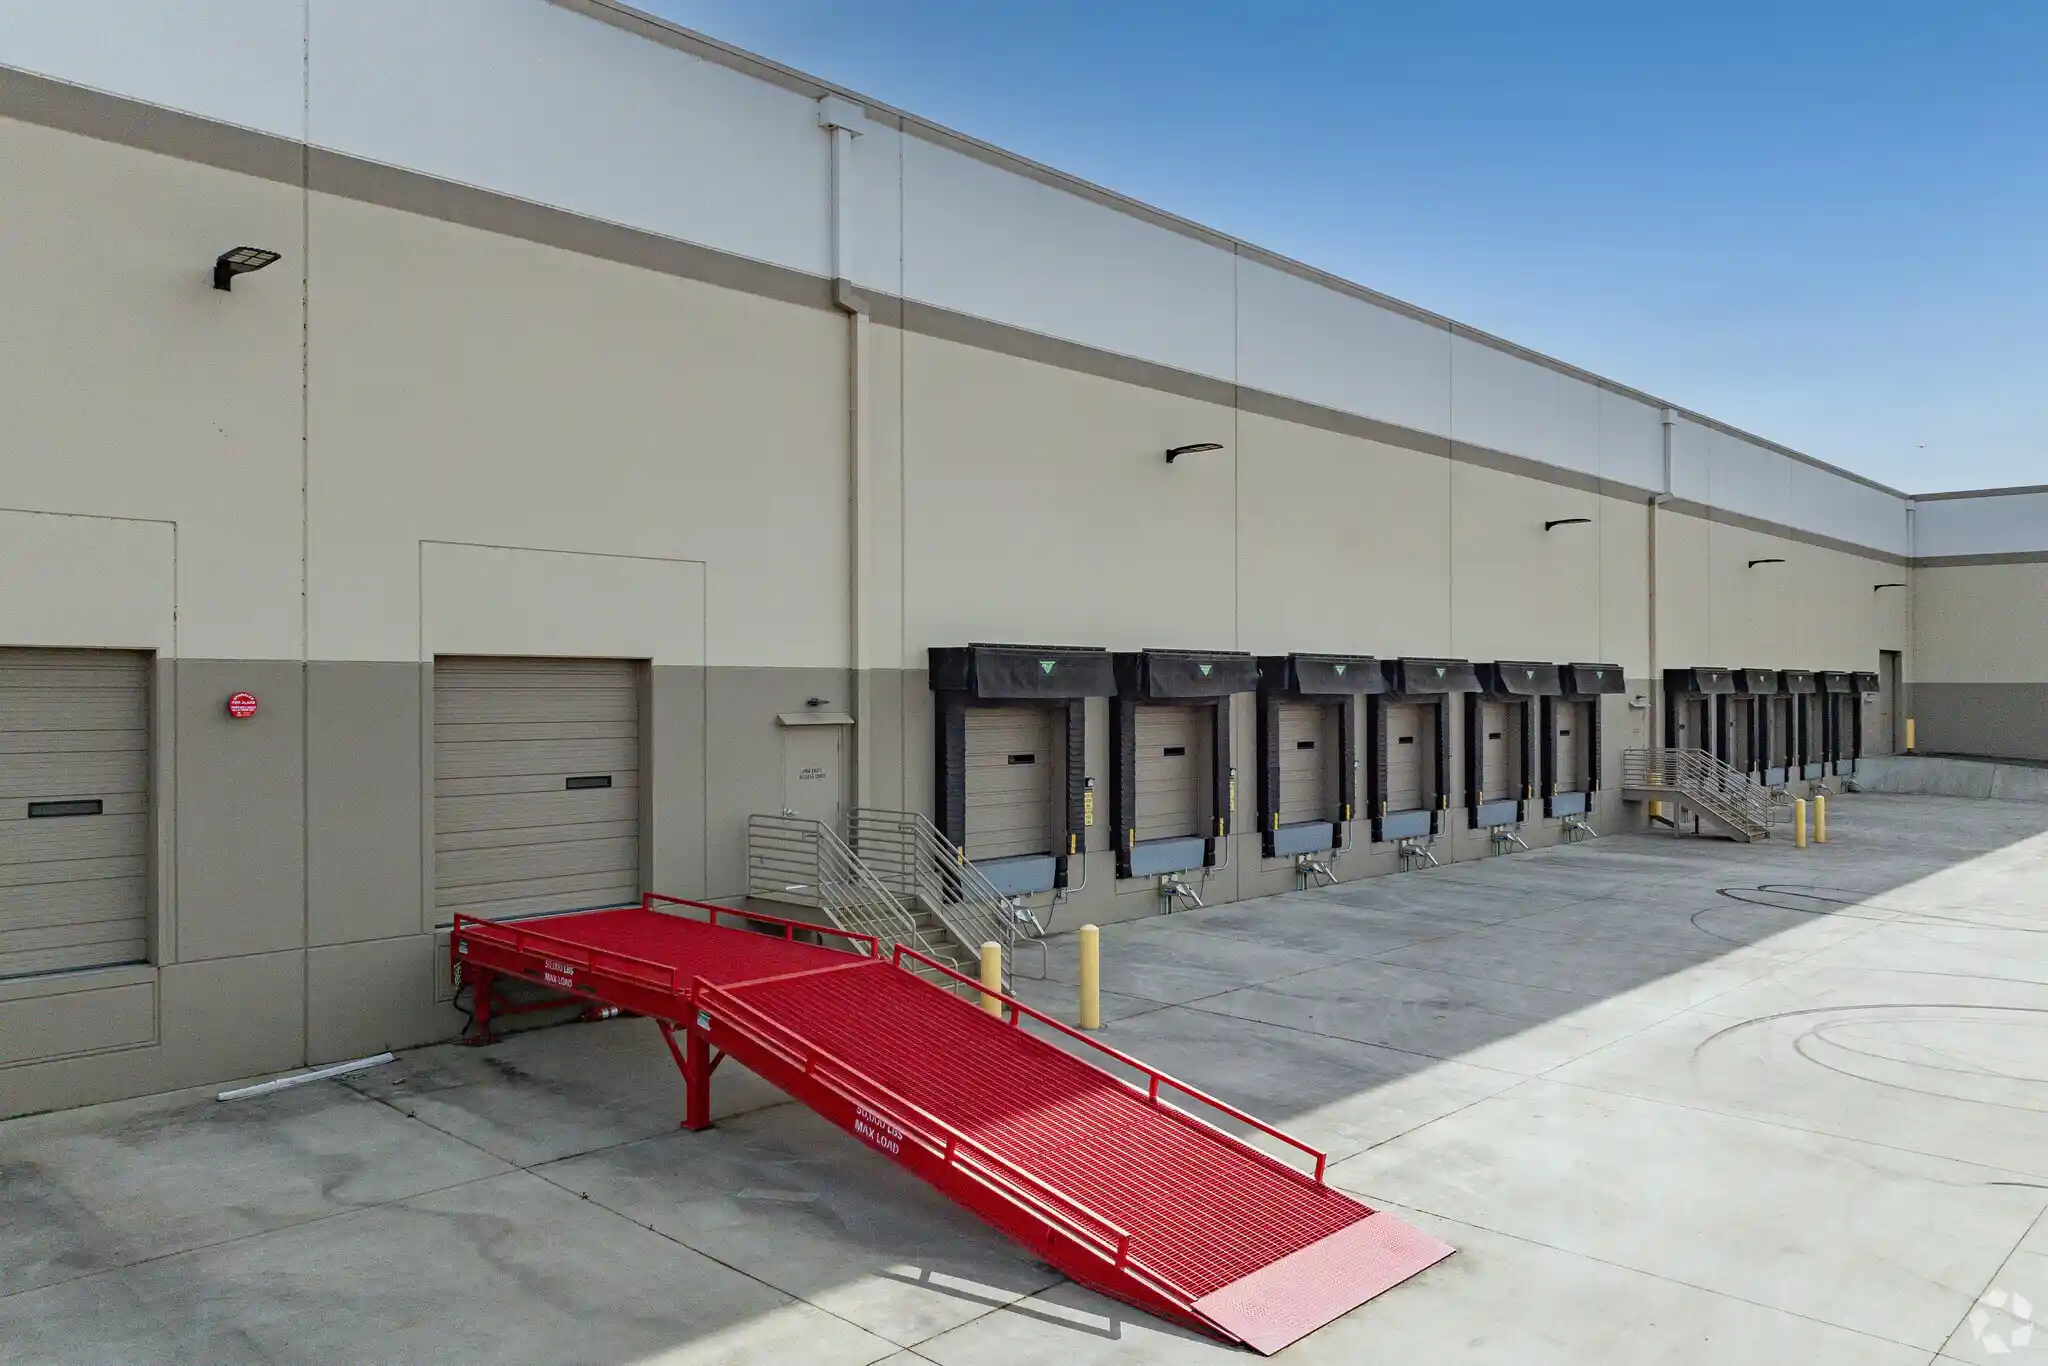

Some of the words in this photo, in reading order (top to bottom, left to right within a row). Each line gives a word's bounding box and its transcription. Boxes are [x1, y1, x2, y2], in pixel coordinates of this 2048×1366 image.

[563, 965, 574, 976] LBS
[544, 972, 557, 984] MAX
[558, 976, 573, 988] LOAD
[855, 1119, 875, 1140] MAX
[876, 1132, 900, 1155] LOAD
